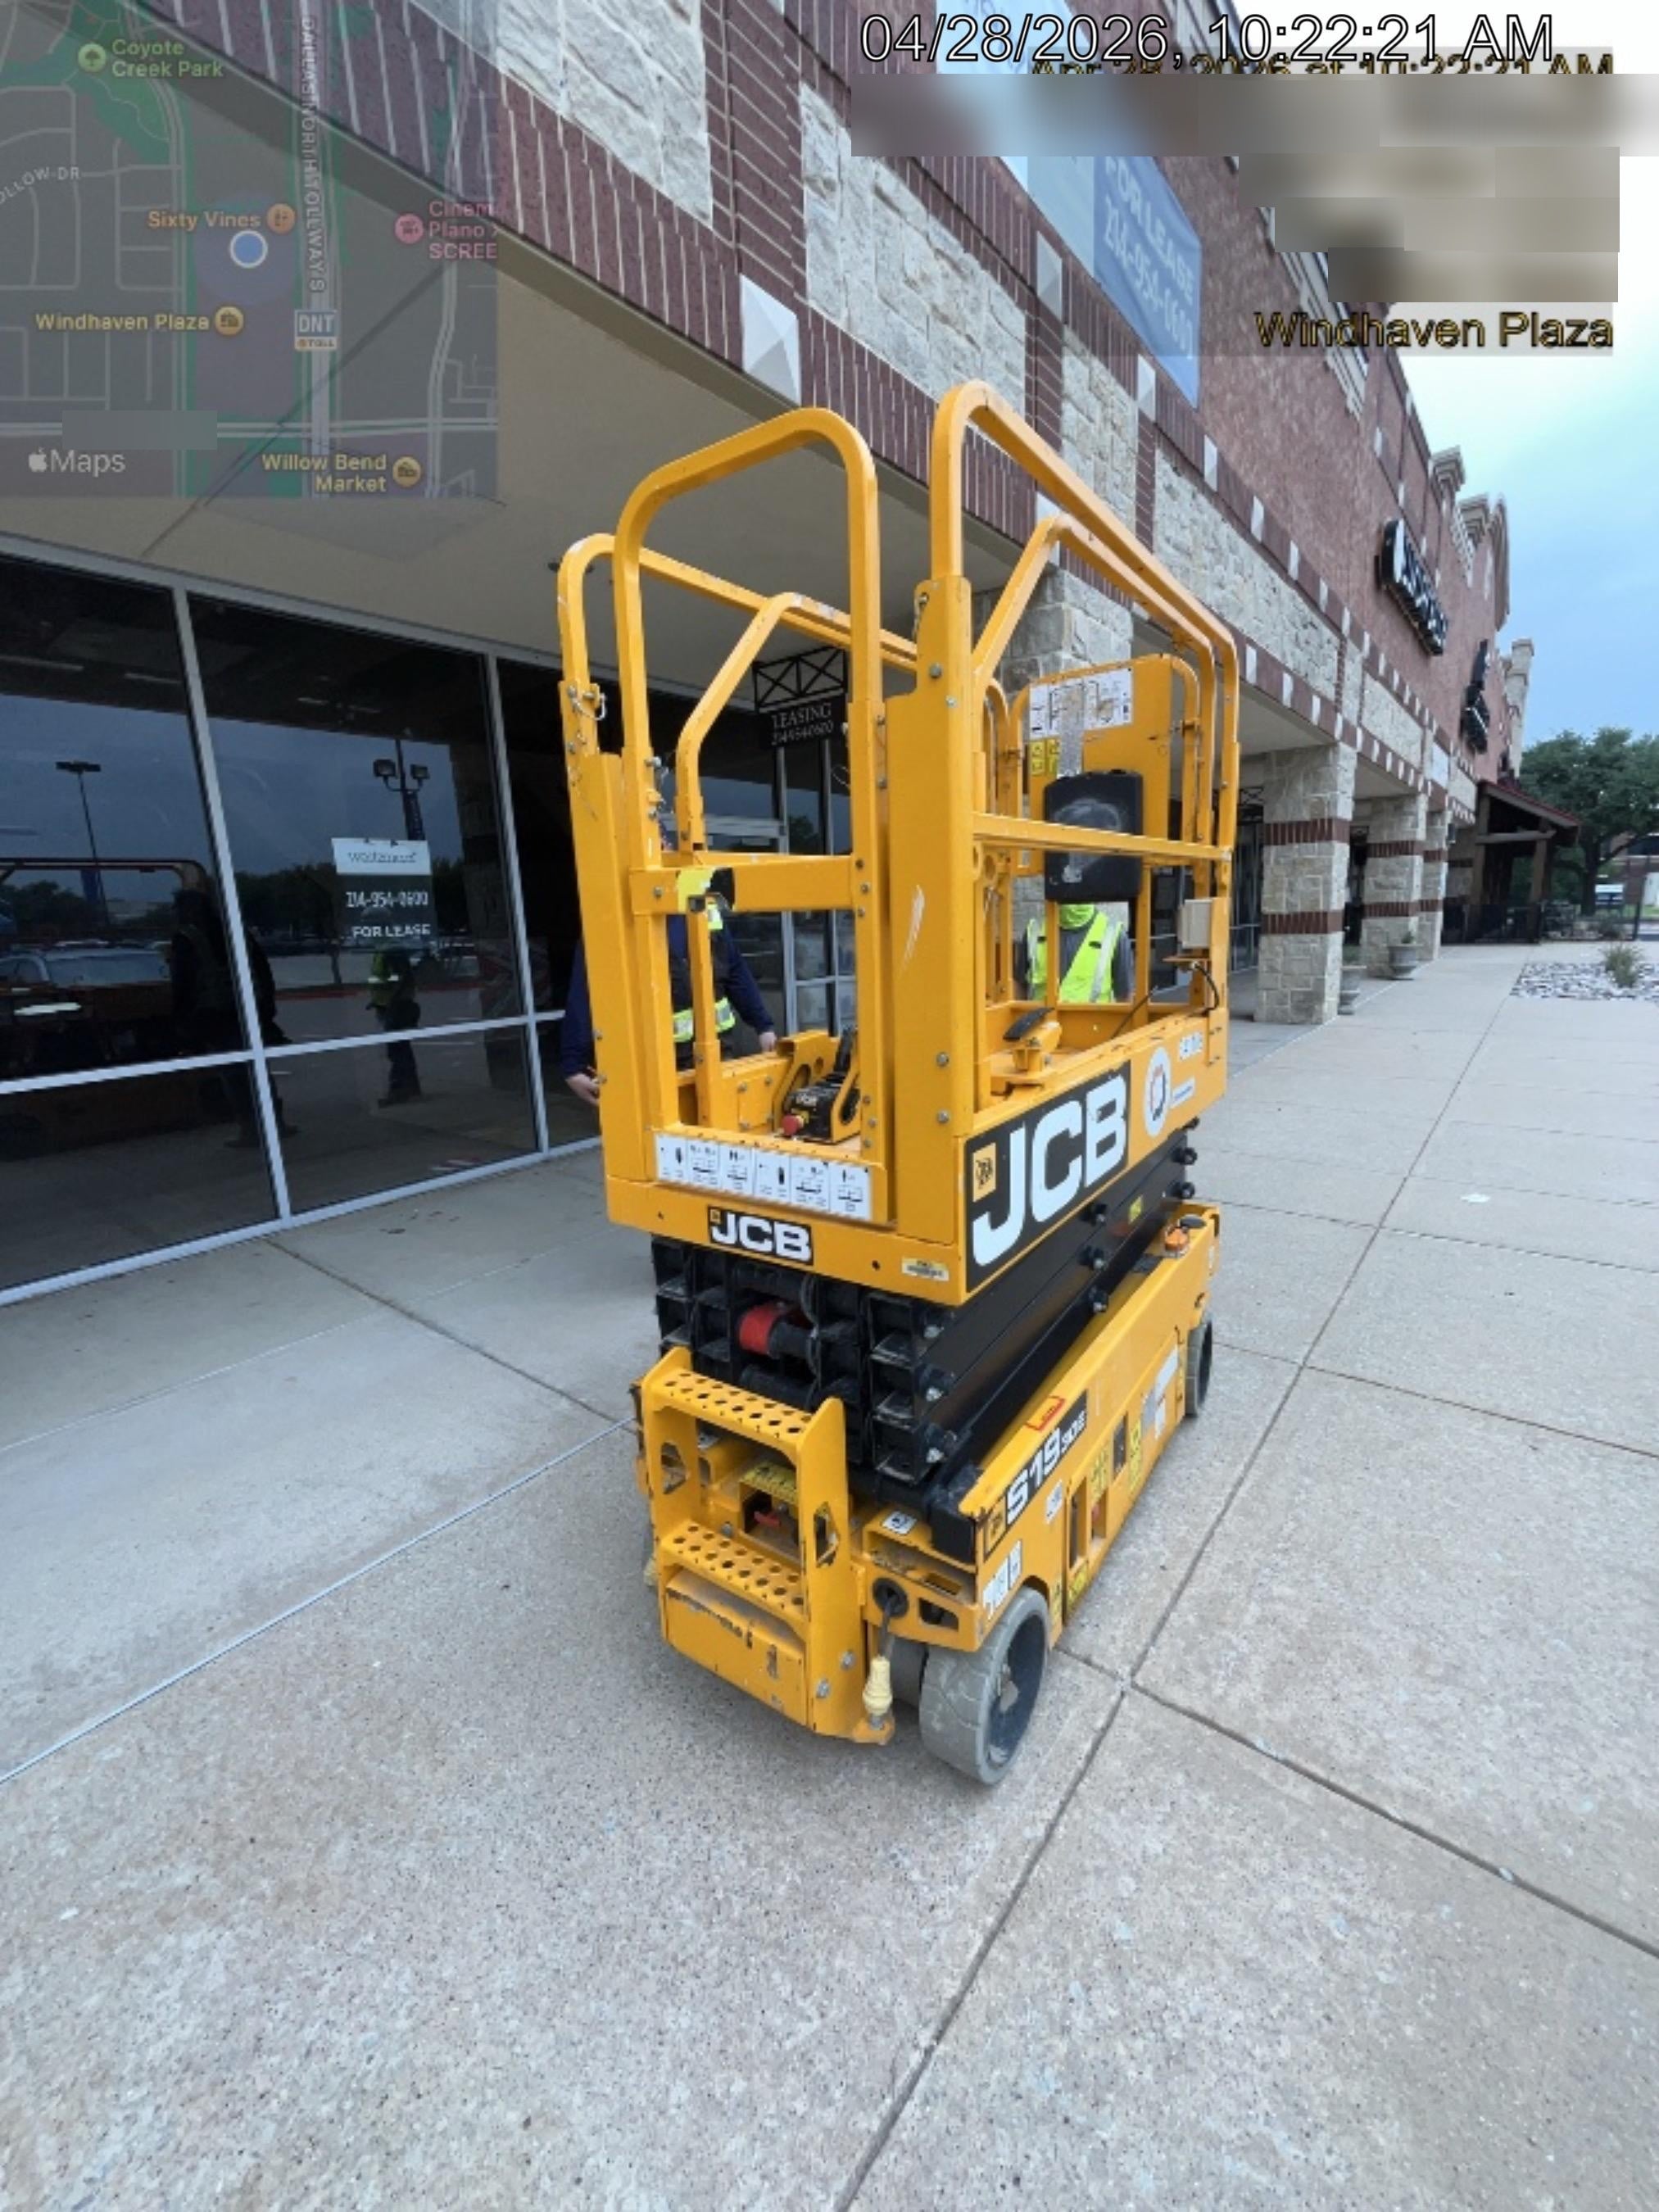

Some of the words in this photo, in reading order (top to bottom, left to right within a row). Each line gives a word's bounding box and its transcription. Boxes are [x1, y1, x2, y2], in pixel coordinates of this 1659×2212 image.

[771, 703, 832, 729] LEASING
[352, 926, 382, 938] FOR
[385, 923, 431, 937] LEASE
[972, 1074, 1127, 1267] JCB
[710, 1212, 811, 1262] JCB
